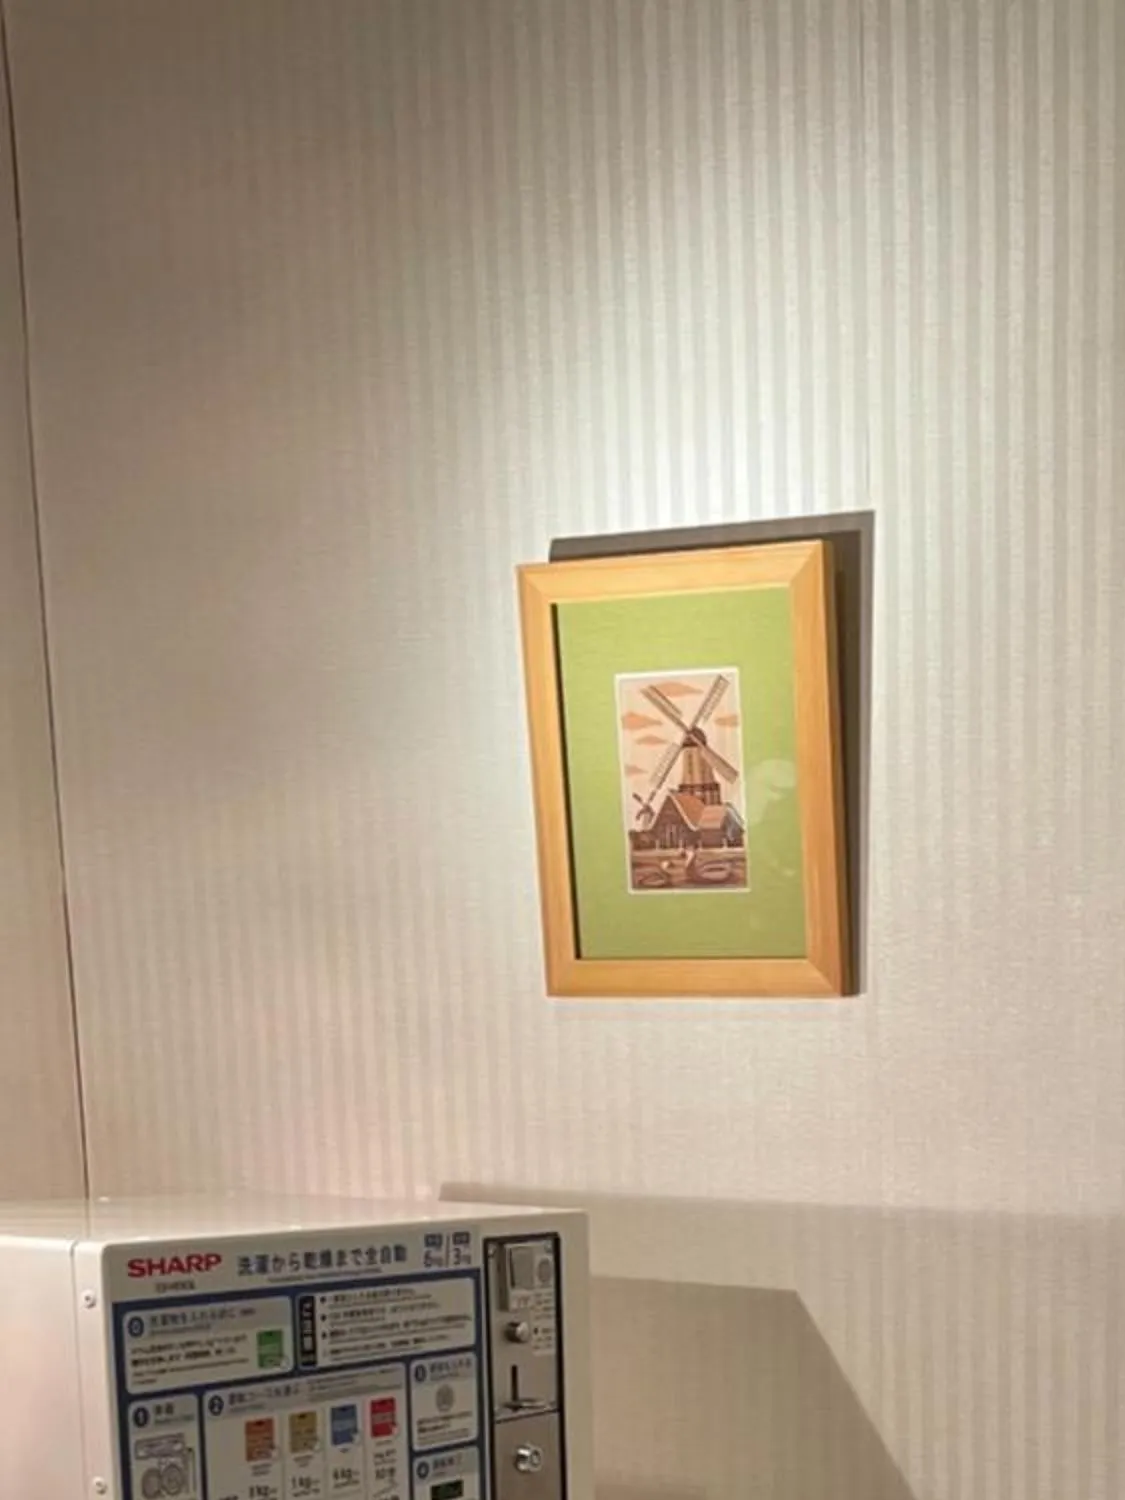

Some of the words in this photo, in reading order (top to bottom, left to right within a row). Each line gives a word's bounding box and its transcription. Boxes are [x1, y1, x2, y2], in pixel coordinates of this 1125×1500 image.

[128, 1253, 222, 1278] SHARP
[238, 1244, 407, 1276] 洗濯から乾燥まで全自動
